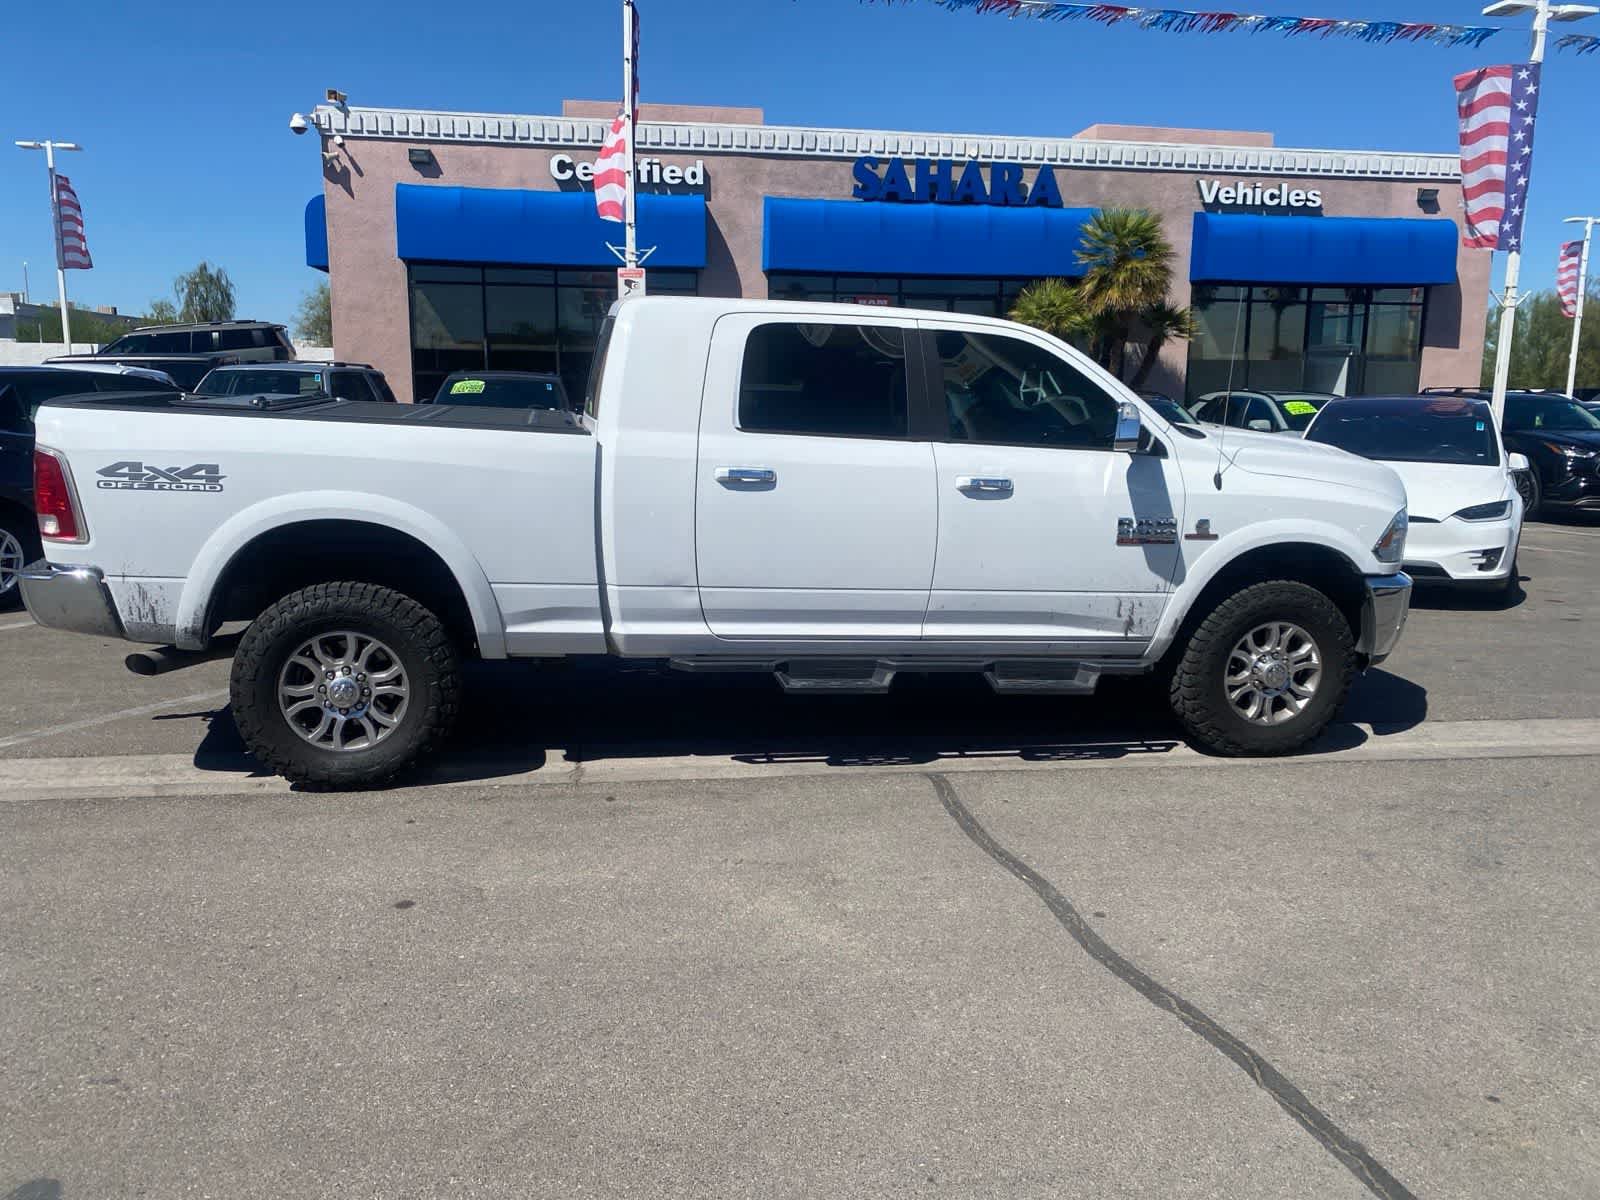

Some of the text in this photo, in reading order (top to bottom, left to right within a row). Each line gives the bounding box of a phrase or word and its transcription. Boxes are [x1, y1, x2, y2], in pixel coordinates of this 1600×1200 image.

[550, 154, 705, 185] Cefied
[852, 156, 1064, 208] SAHARA
[1199, 179, 1322, 208] Vehicles
[99, 480, 221, 491] OFF ROAD
